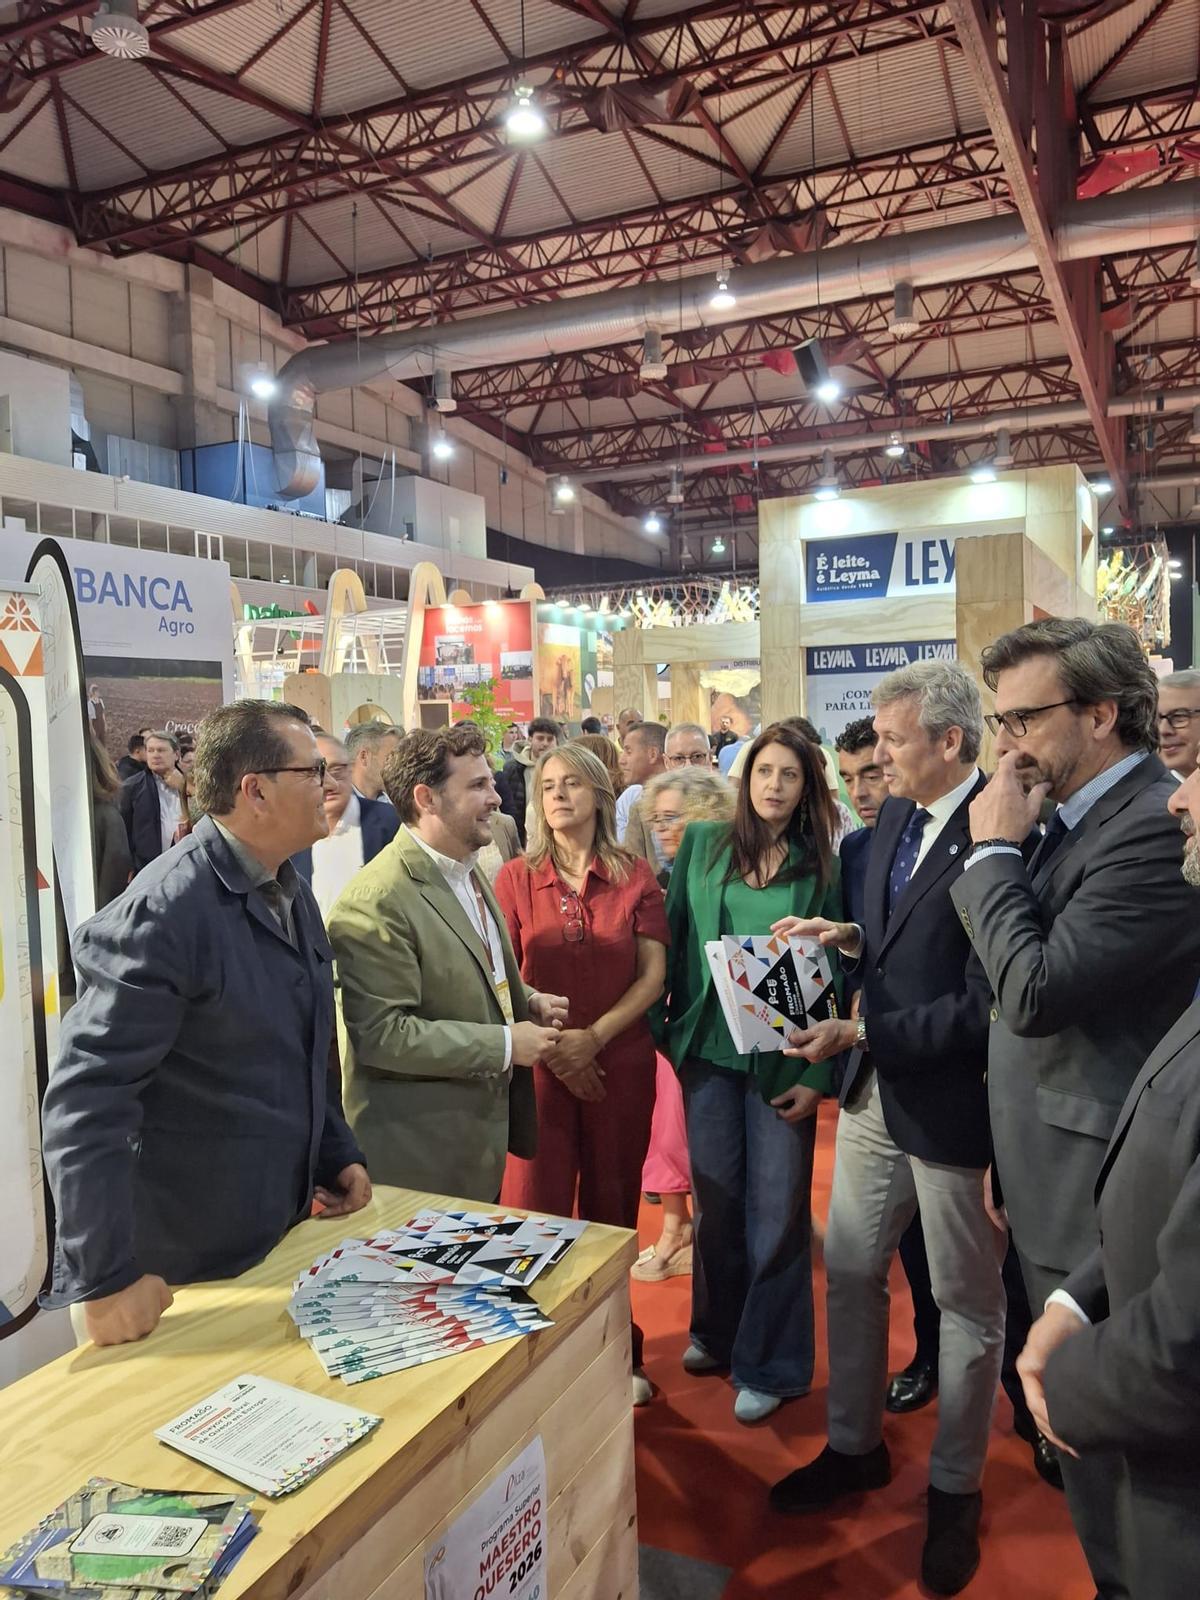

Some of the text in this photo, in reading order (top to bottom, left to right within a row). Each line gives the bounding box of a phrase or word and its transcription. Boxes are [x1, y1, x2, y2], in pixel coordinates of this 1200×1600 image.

[816, 553, 870, 570] É leite,
[816, 569, 880, 584] é Leyma
[905, 539, 956, 586] LEY
[74, 567, 193, 613] BANCA
[159, 616, 195, 637] Agro
[813, 643, 957, 670] LEYMA LEYMA LEYM
[825, 702, 856, 711] PARA
[479, 1499, 541, 1579] MAESTRO
[481, 1514, 514, 1552] Programa
[512, 1484, 540, 1517] Superior
[474, 1519, 541, 1600] QUESERO
[509, 1540, 542, 1594] 2026
